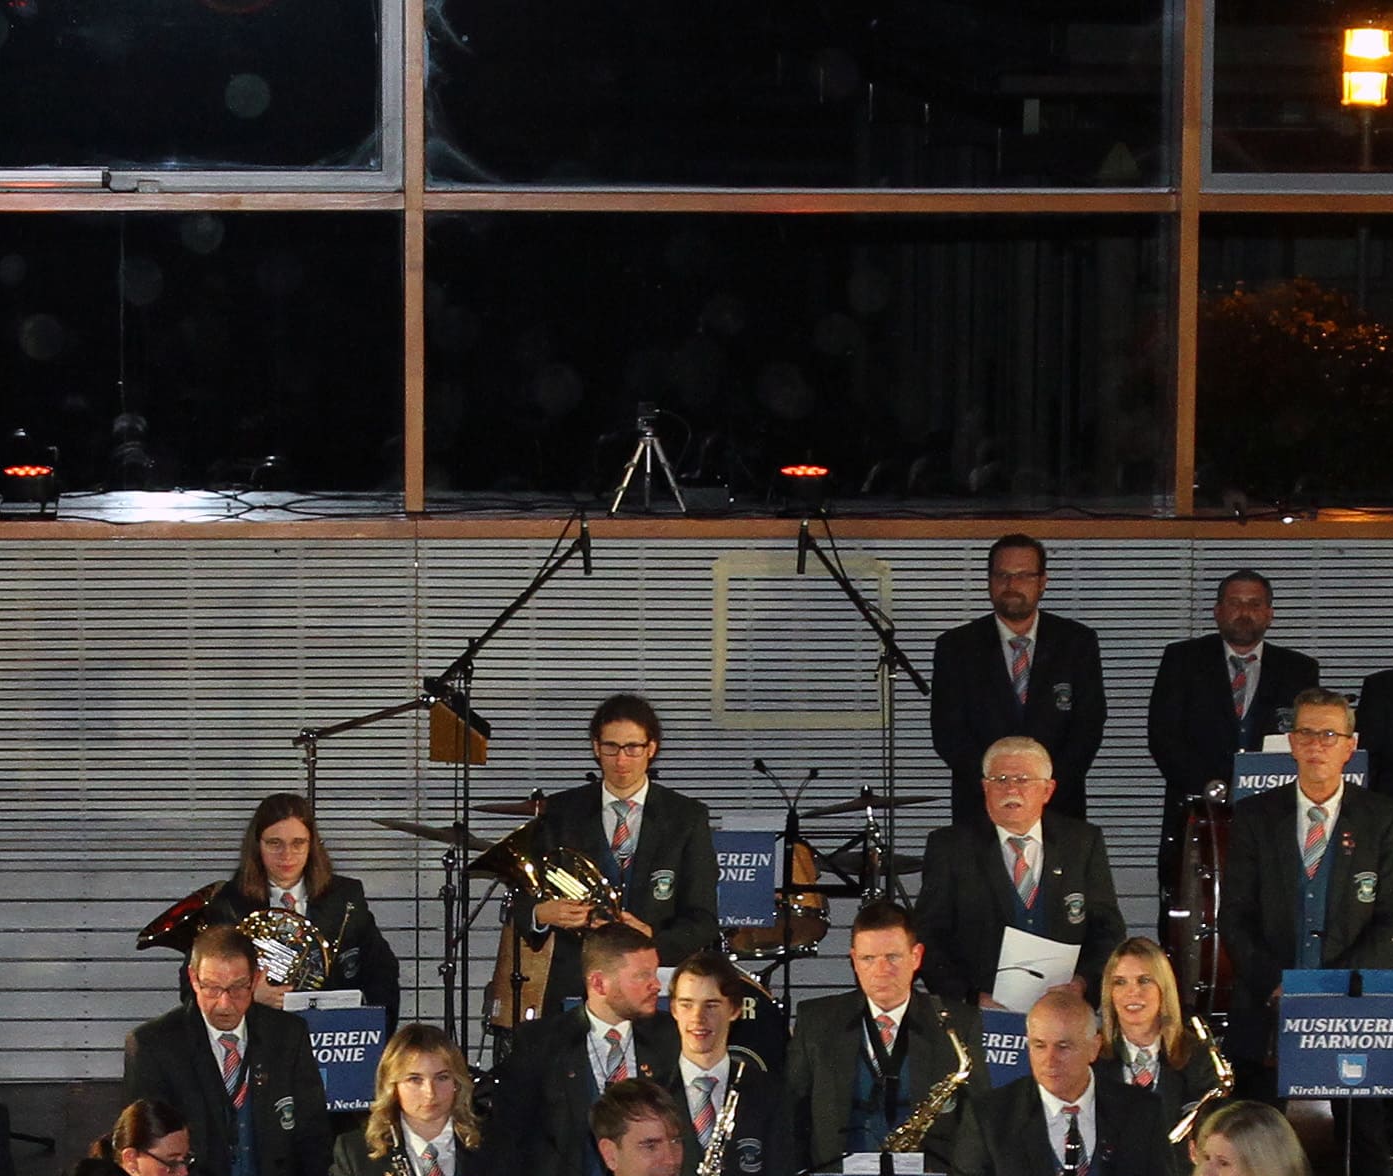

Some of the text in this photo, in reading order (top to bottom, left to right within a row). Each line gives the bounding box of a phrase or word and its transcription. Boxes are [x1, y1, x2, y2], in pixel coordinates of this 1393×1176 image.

[726, 915, 765, 925] Neckar
[309, 1031, 381, 1047] VEREIN
[312, 1047, 366, 1063] ONIE
[1289, 1086, 1349, 1095] Kirchheim
[1352, 1087, 1370, 1095] am
